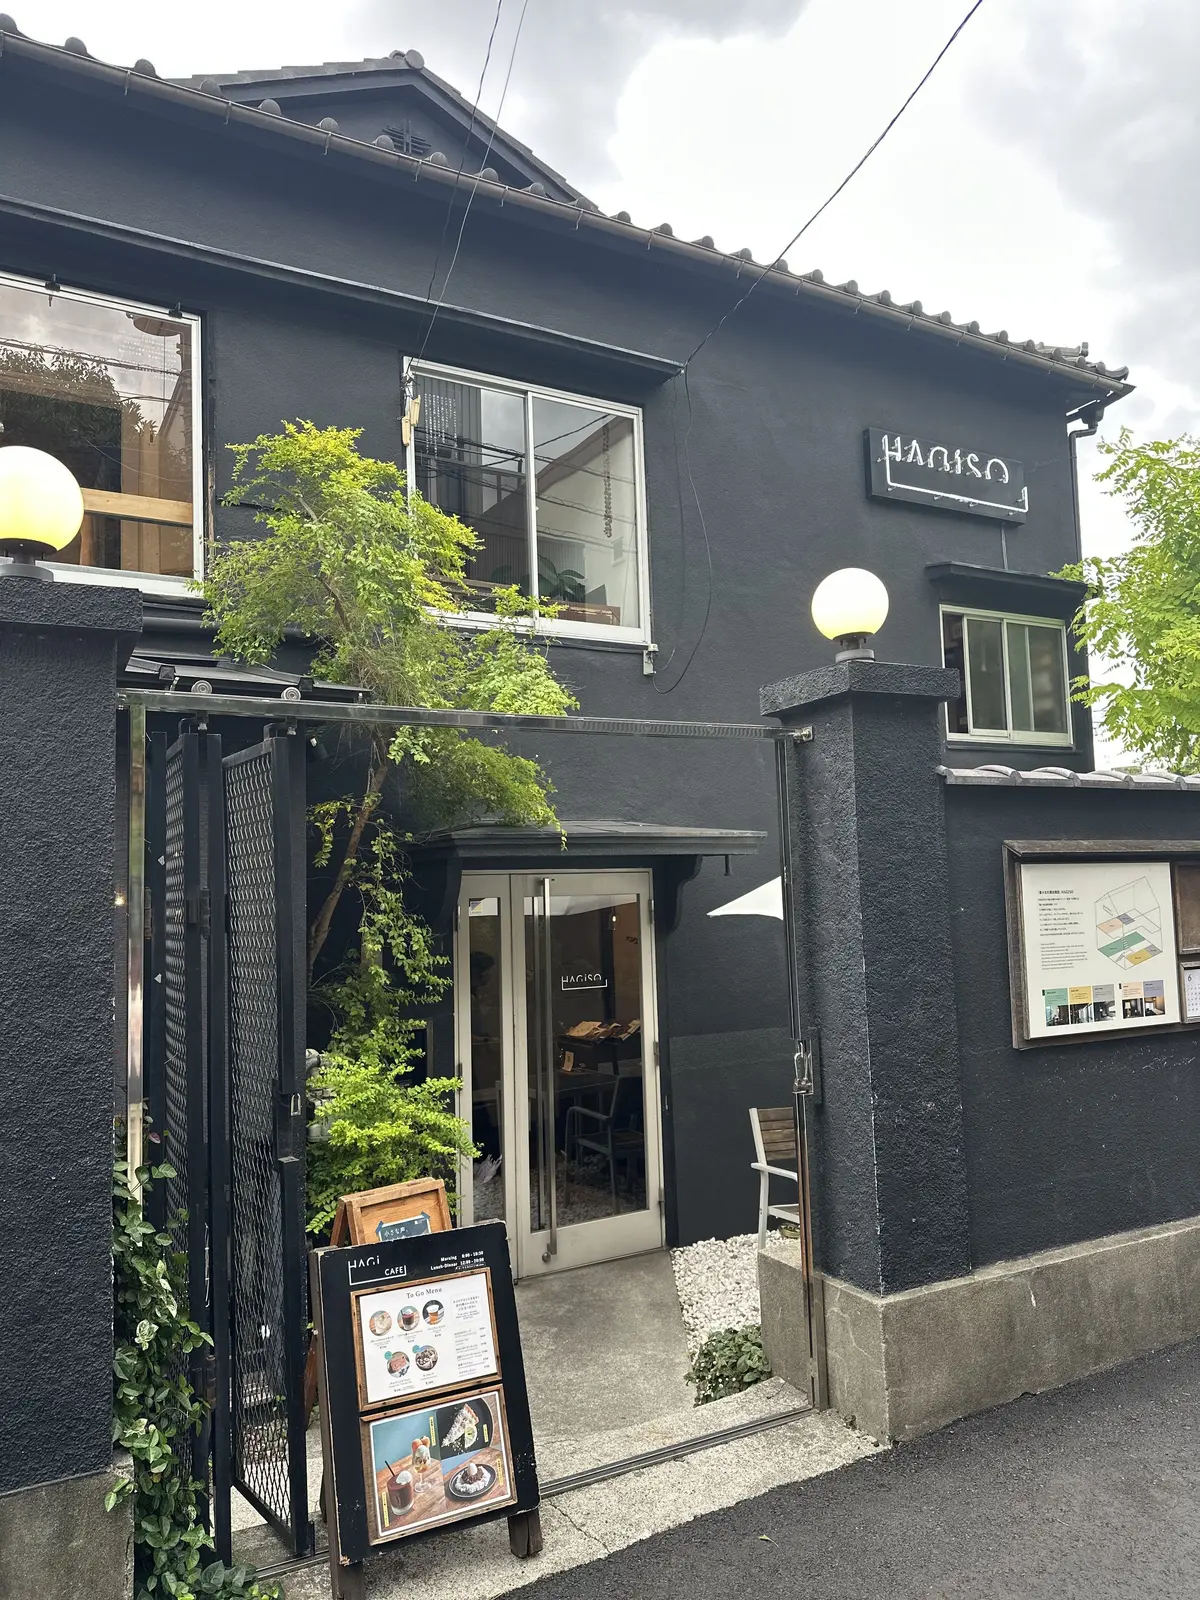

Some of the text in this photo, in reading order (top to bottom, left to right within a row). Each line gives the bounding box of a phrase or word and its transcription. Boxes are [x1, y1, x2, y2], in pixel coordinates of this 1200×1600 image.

[1187, 974, 1192, 982] 6
[384, 1265, 404, 1276] CAFE
[416, 1290, 425, 1298] Go
[426, 1287, 443, 1296] Menu
